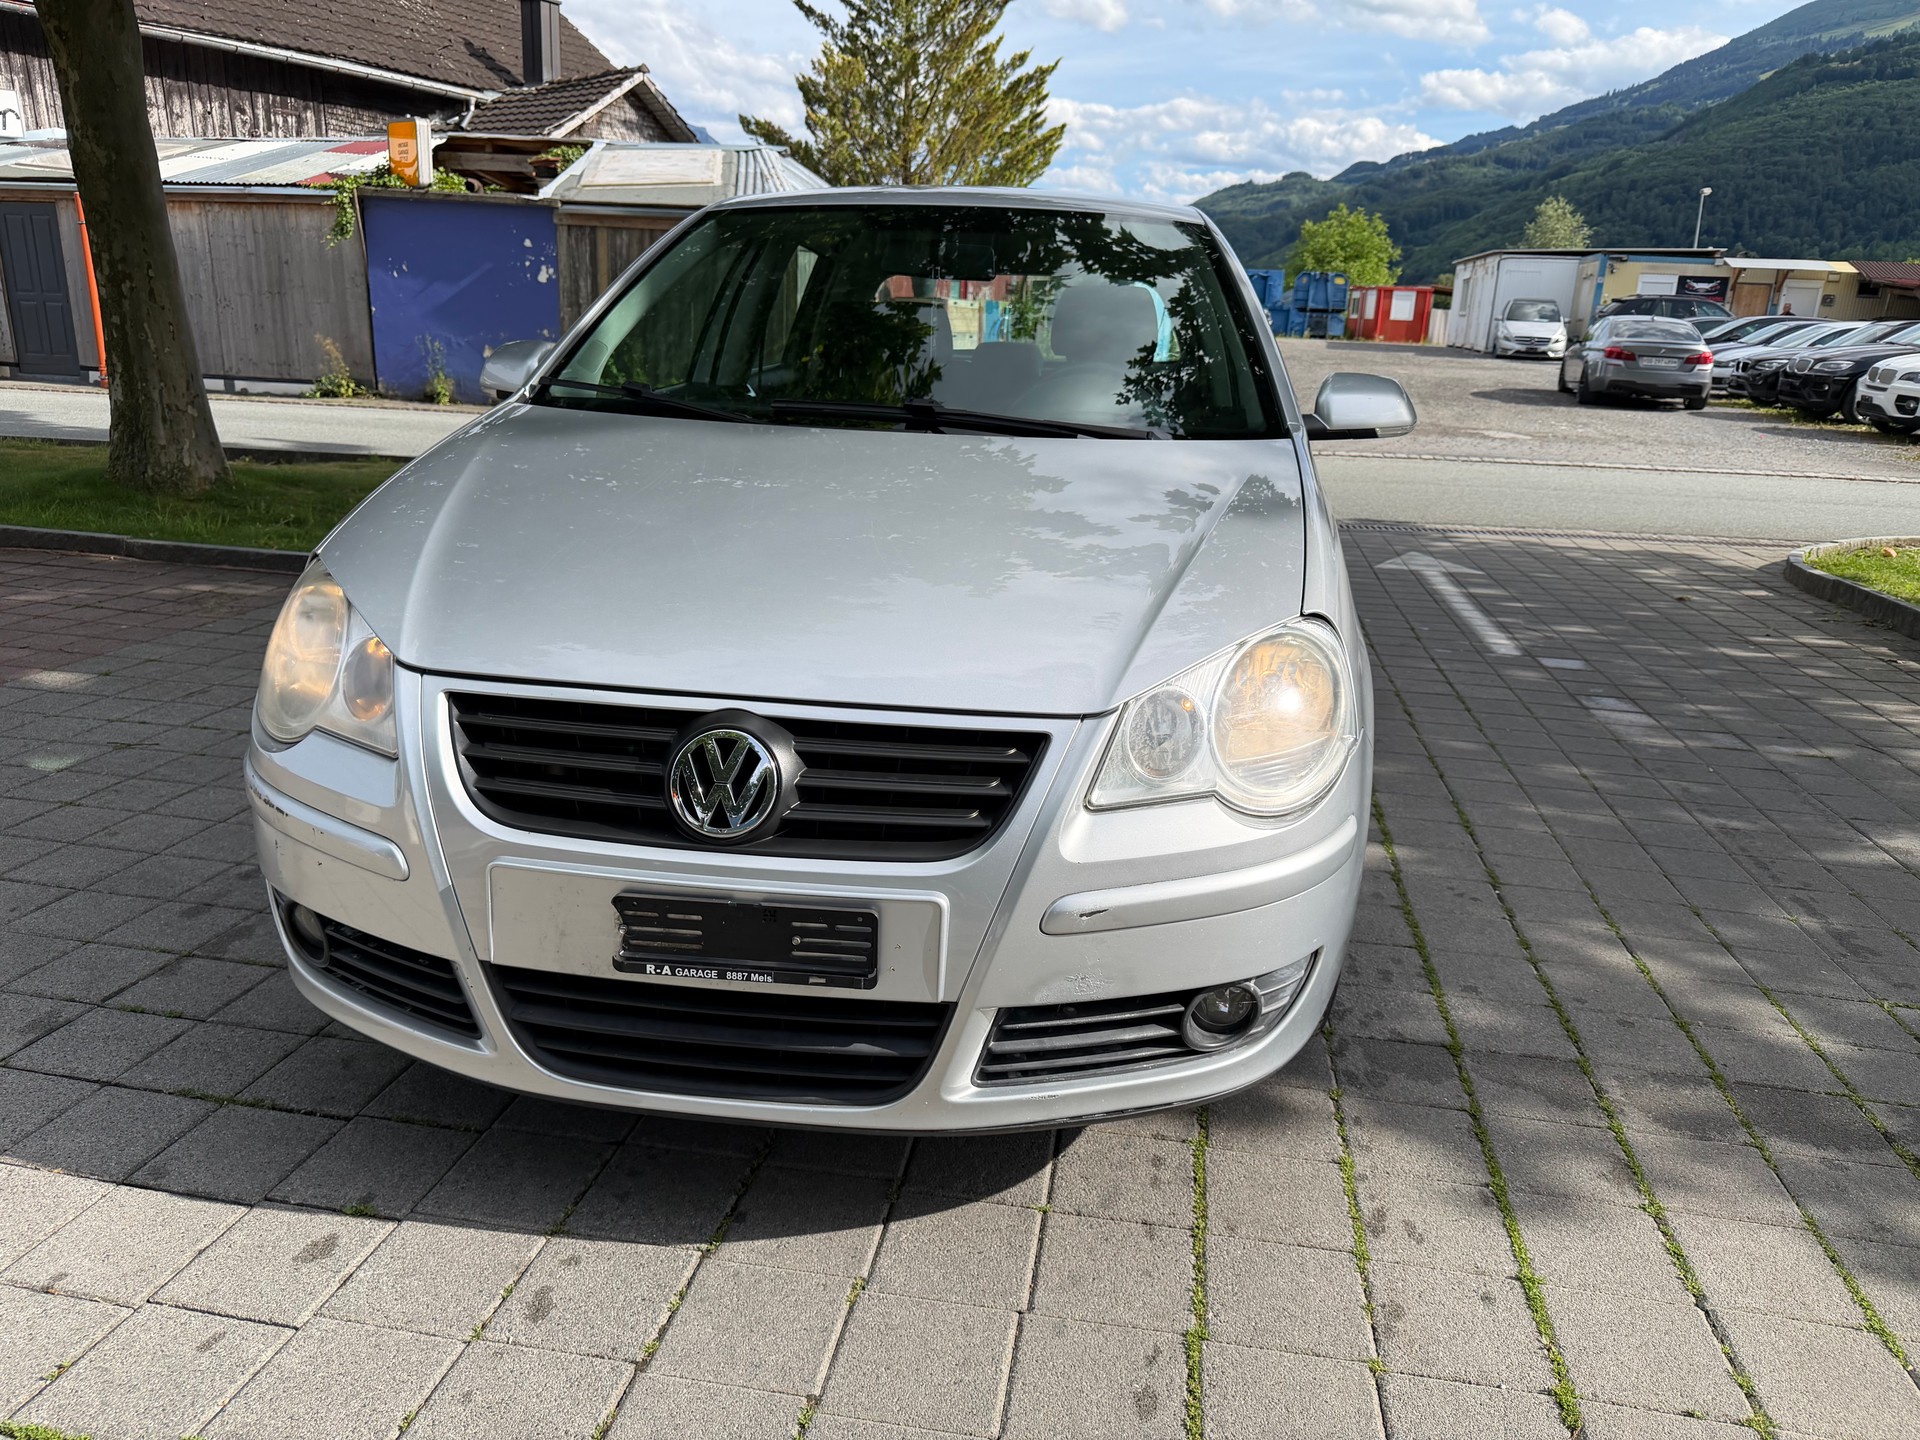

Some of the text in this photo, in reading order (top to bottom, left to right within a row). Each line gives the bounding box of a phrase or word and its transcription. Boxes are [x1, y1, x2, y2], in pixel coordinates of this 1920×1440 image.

[646, 964, 772, 982] R-A GARAGE 8887 Mels
